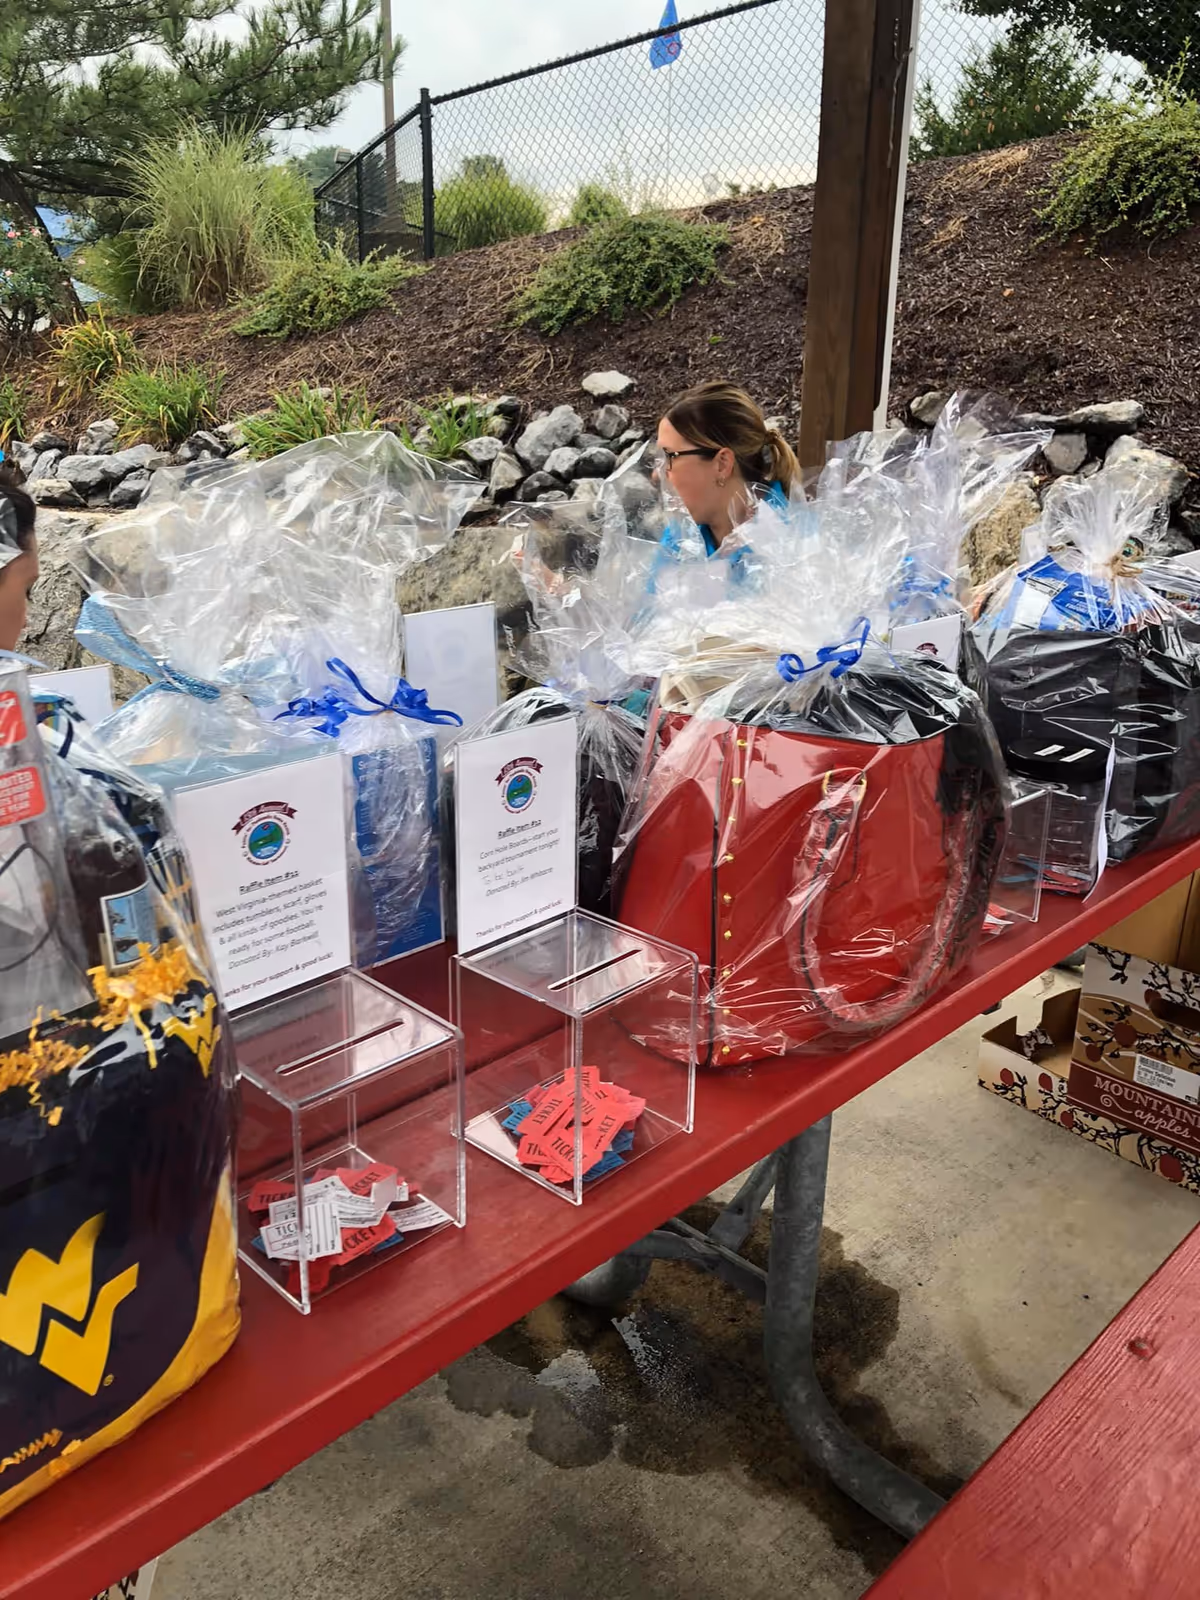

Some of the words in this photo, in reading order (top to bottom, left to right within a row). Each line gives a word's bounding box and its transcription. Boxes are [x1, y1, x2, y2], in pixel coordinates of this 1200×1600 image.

[239, 880, 263, 893] Raffle
[264, 874, 282, 886] Item
[212, 917, 245, 933] includes
[304, 890, 327, 904] gloves
[215, 907, 236, 918] West
[299, 878, 323, 891] basket
[228, 953, 260, 969] Donated
[252, 977, 268, 988] your
[269, 967, 294, 982] support
[301, 957, 317, 970] good
[532, 1098, 562, 1126] TICKET
[1134, 1110, 1191, 1138] apples
